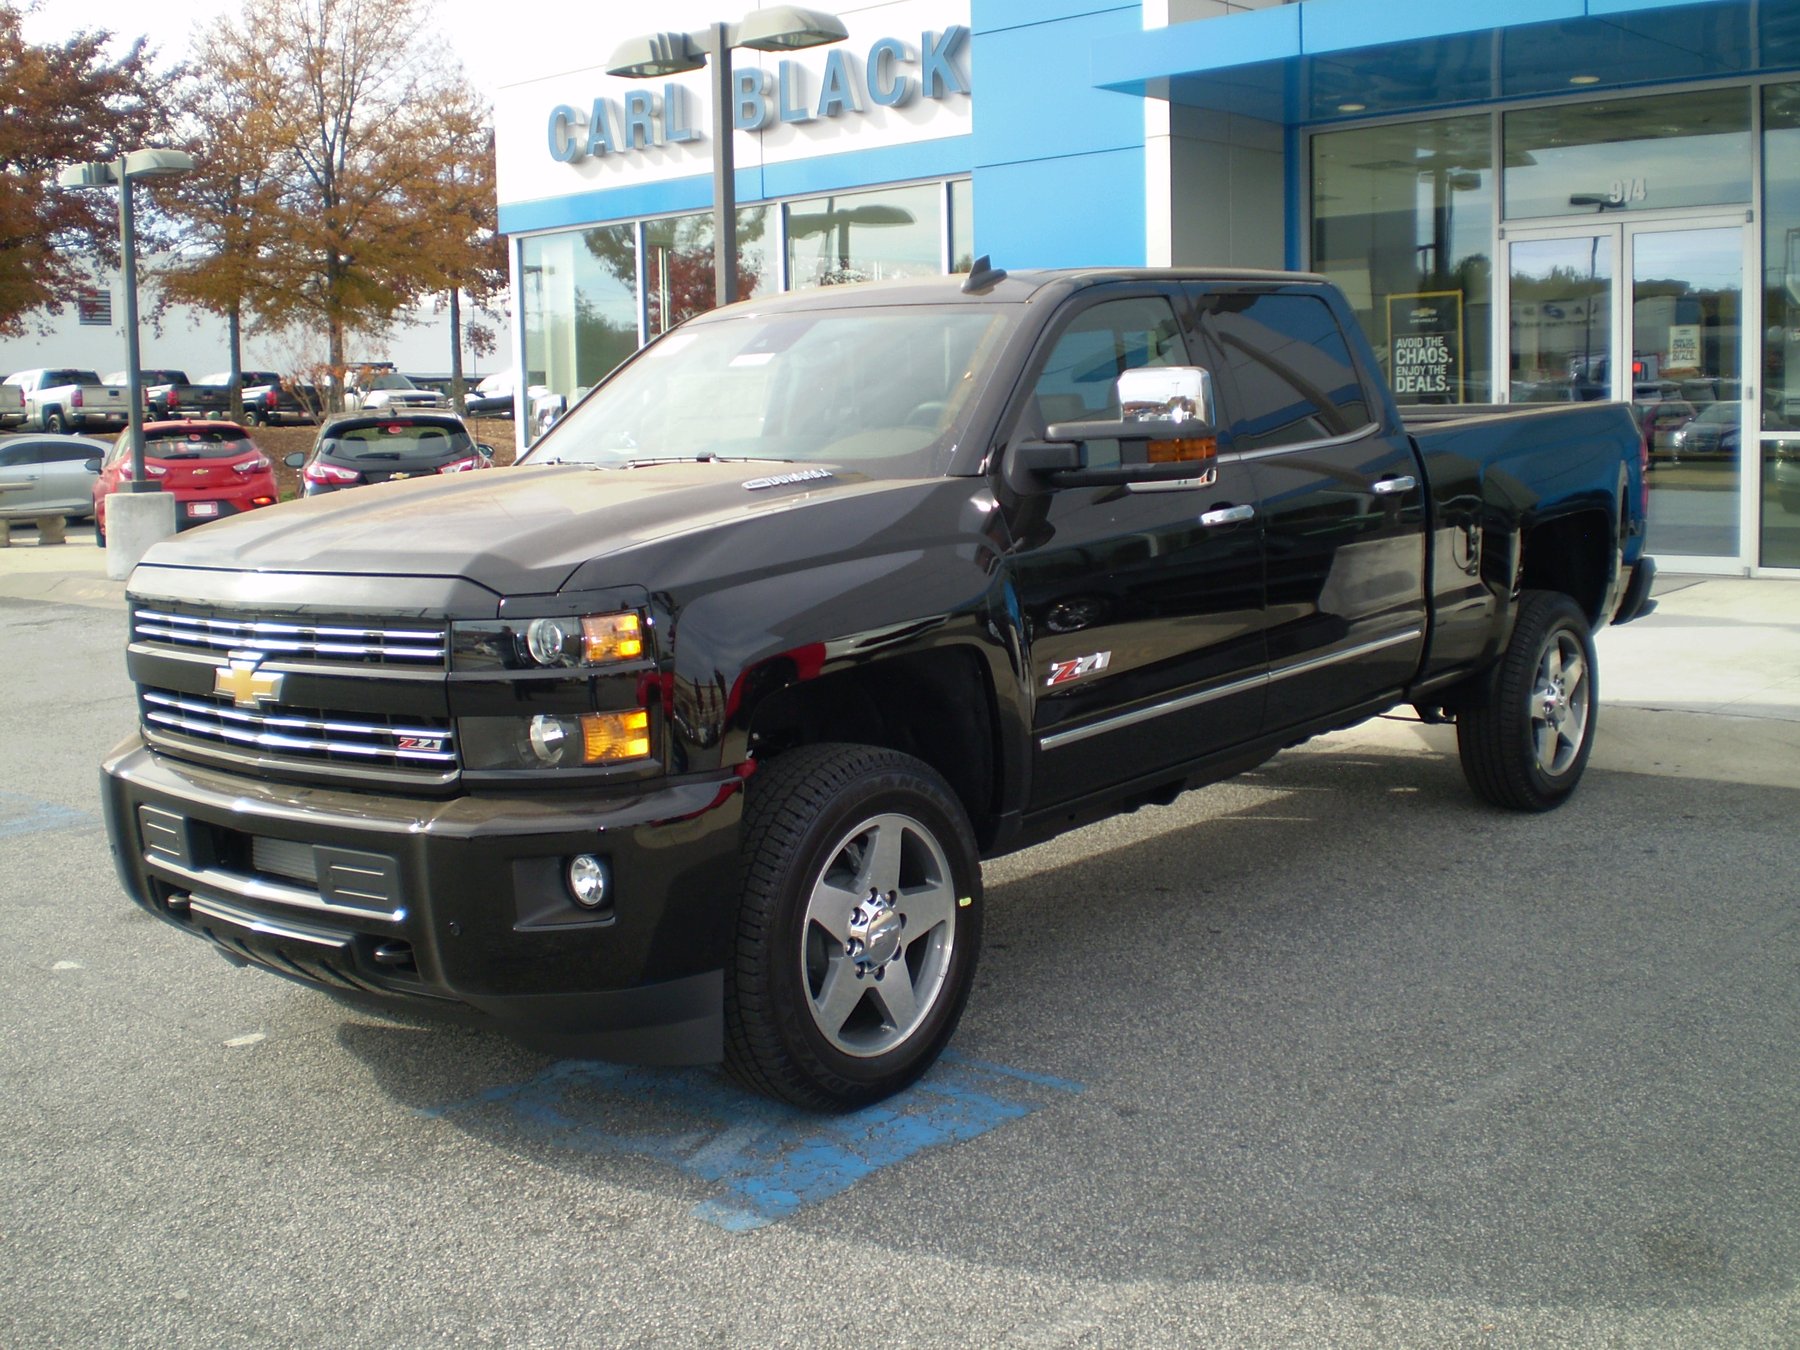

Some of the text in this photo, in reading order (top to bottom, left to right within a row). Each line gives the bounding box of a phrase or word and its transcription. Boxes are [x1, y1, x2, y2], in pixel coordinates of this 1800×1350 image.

[548, 25, 971, 163] CARL BLACK
[1609, 176, 1647, 203] 974
[1396, 336, 1444, 348] AVOID THE
[1396, 347, 1453, 364] CHAOS.
[1396, 365, 1447, 375] ENJOY THE
[1396, 375, 1450, 392] DEALS.
[1047, 650, 1111, 686] Z71
[398, 736, 442, 752] Z71
